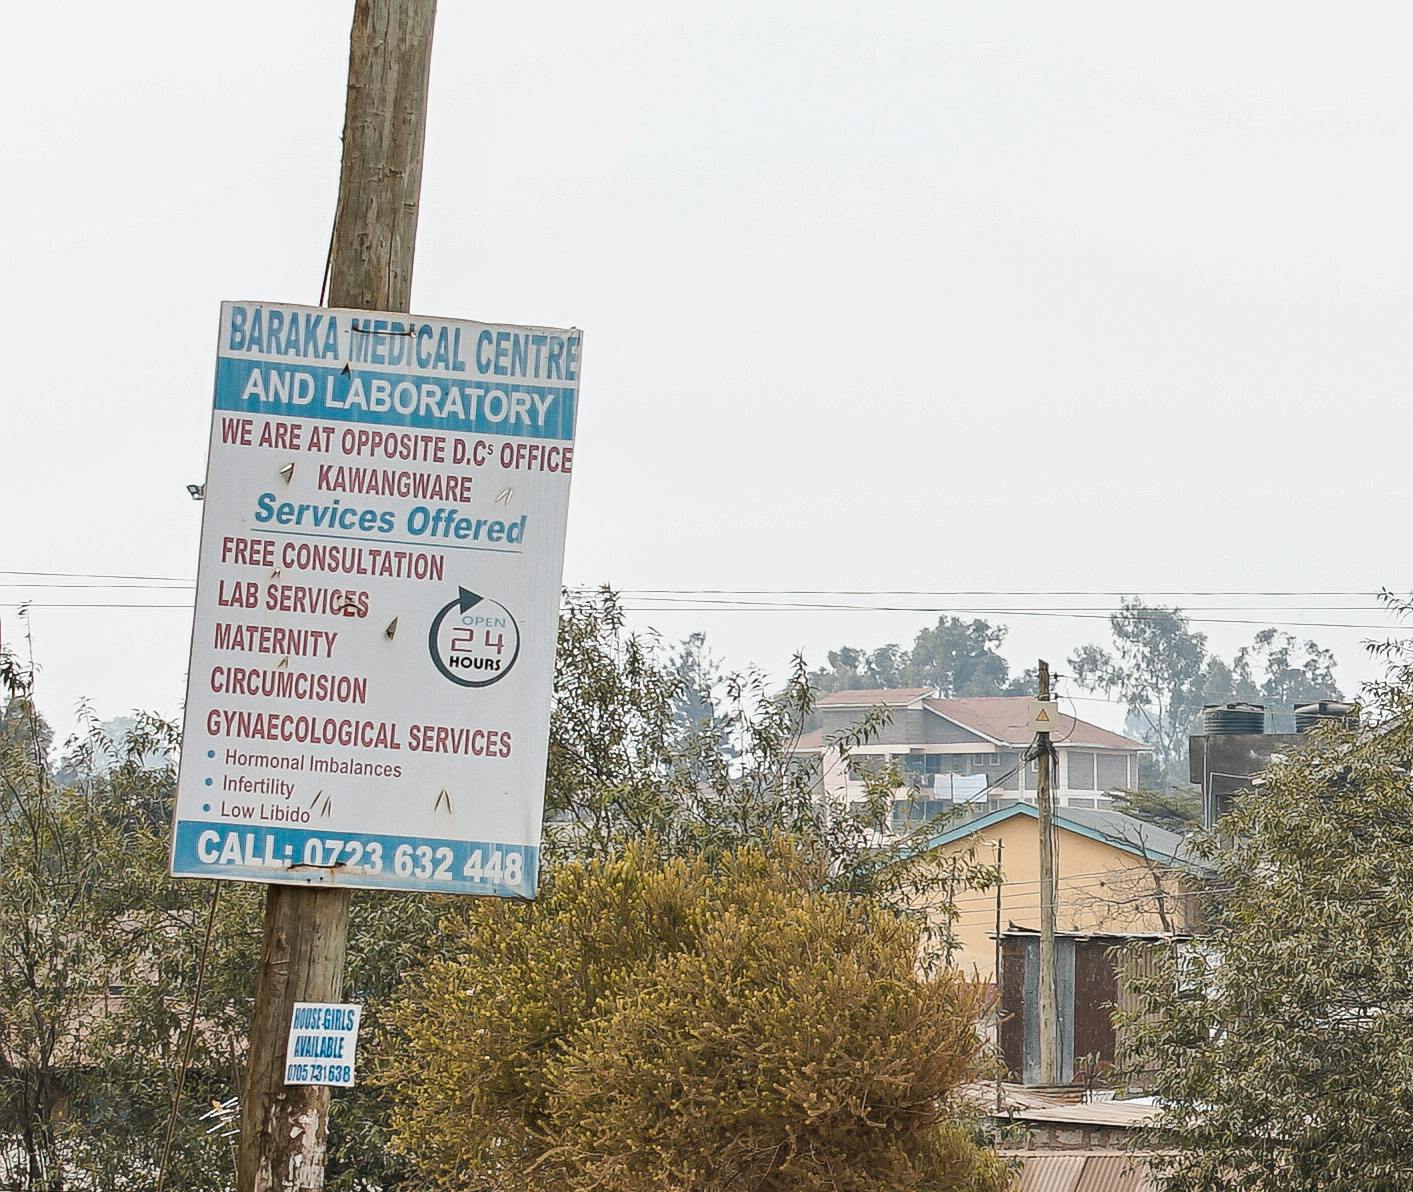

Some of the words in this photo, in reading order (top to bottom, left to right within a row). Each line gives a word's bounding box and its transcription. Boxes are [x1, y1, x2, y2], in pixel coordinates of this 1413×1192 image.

[229, 305, 339, 361] BARAKA
[350, 317, 467, 373] MEDICAL
[476, 329, 581, 382] CENTRE
[241, 367, 315, 405] AND
[325, 375, 555, 427] LABORATORY
[221, 417, 252, 446] WE
[259, 421, 302, 450] ARE
[307, 426, 336, 453] AT
[341, 428, 446, 463] OPPOSITE
[500, 444, 574, 474] OFFICE
[317, 464, 472, 503] KAWANGWARE
[255, 492, 395, 534] Services
[406, 505, 528, 545] Offered
[221, 536, 275, 567] FREE
[281, 541, 445, 581] CONSULTATION
[217, 579, 258, 609] LAB
[265, 583, 369, 619] SERVICES
[213, 622, 338, 658] MATERNITY
[462, 615, 507, 629] OPEN
[450, 626, 505, 656] 24
[449, 655, 502, 672] HOURS
[210, 665, 368, 704] CIRCUMCISION
[206, 709, 401, 751] GYNAECOLOGICAL
[408, 724, 512, 758] SERVICES
[225, 749, 305, 772] Hormonal
[309, 755, 402, 779] Imbalances
[222, 774, 295, 800] Infertility
[220, 800, 255, 820] Low
[260, 804, 311, 823] Libido
[196, 829, 293, 867] CALL:
[303, 837, 384, 876] 0723
[394, 843, 454, 881] 632
[463, 849, 523, 887] 448
[293, 1007, 323, 1030] HOUSE
[324, 1007, 355, 1031] GIRLS
[293, 1036, 345, 1058] AVAILABLE
[328, 1064, 351, 1083] 638
